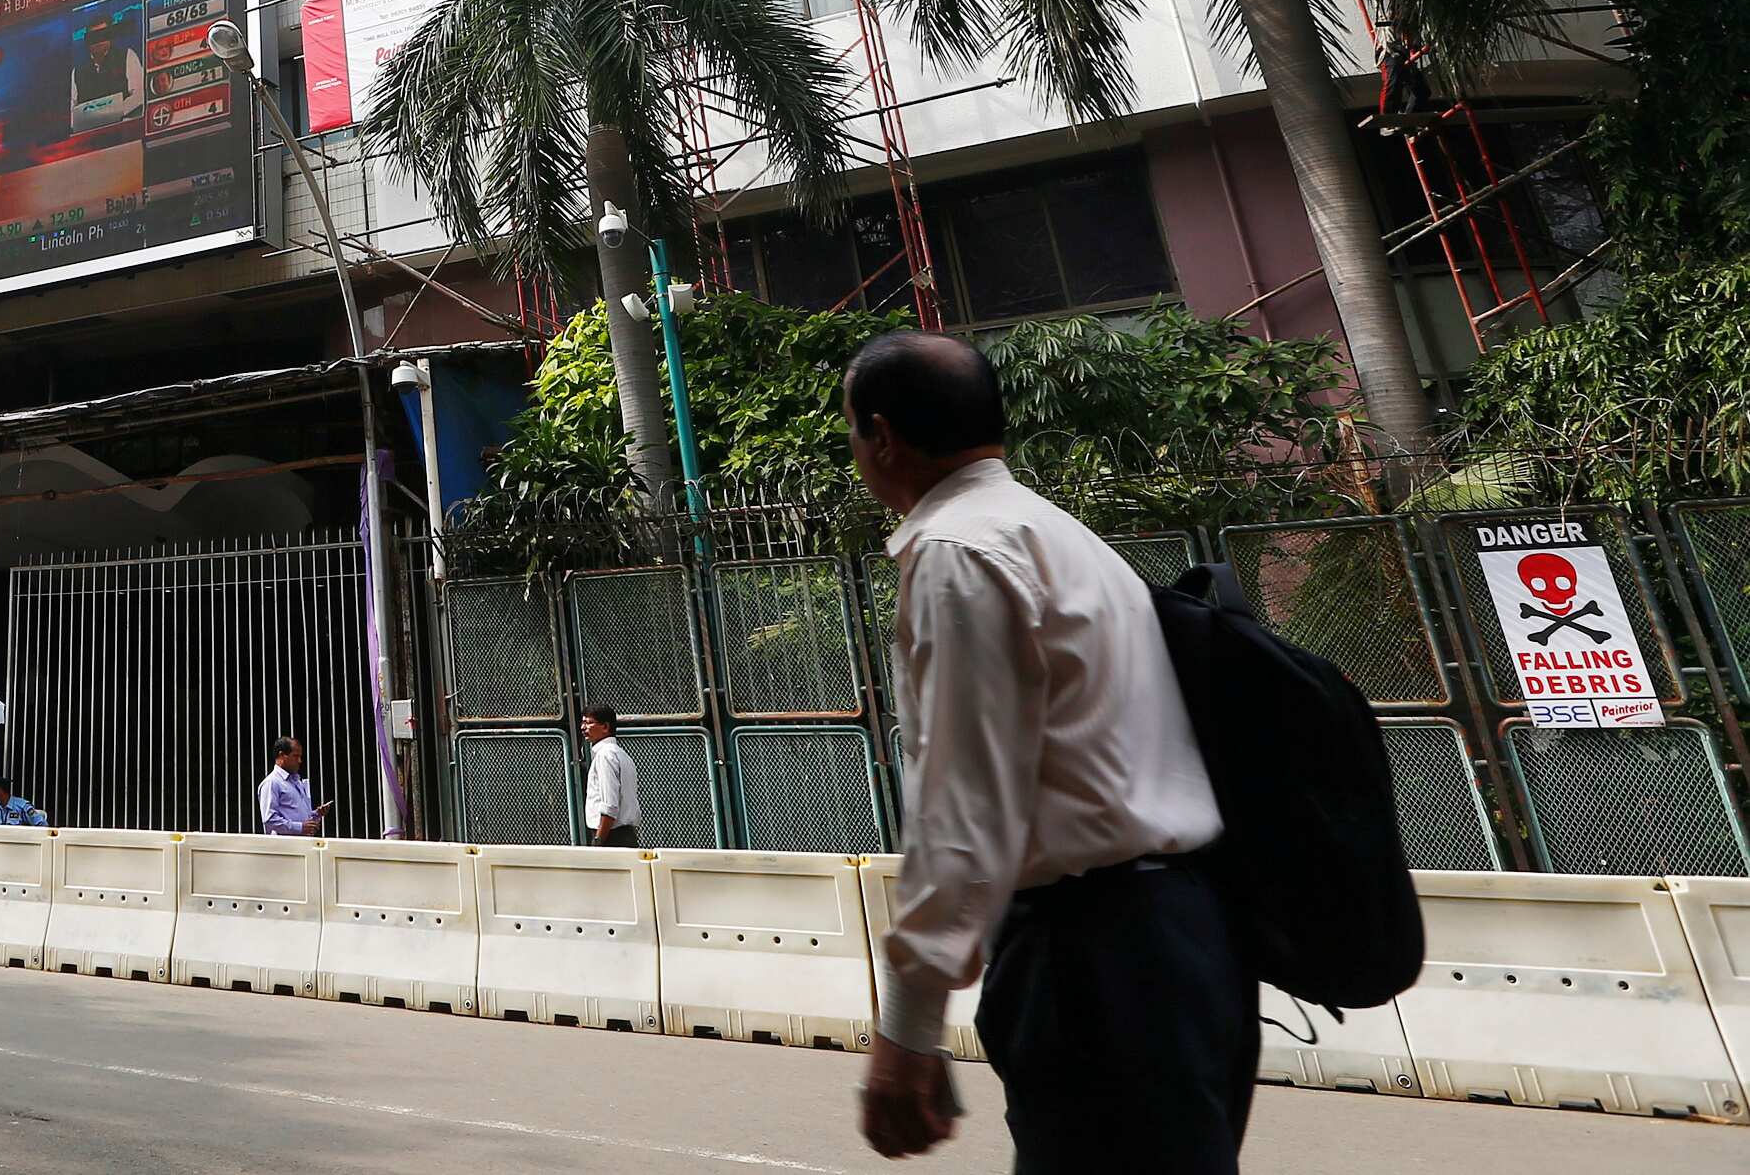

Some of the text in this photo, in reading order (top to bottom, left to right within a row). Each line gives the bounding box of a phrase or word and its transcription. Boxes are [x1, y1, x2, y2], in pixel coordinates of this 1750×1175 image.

[166, 3, 208, 27] 68/68
[208, 102, 218, 115] 4
[1476, 522, 1588, 547] DANGER
[1517, 649, 1633, 671] FALLING
[1525, 674, 1642, 695] DEBRIS
[1532, 705, 1593, 724] BSE
[1601, 701, 1654, 718] Painterior
